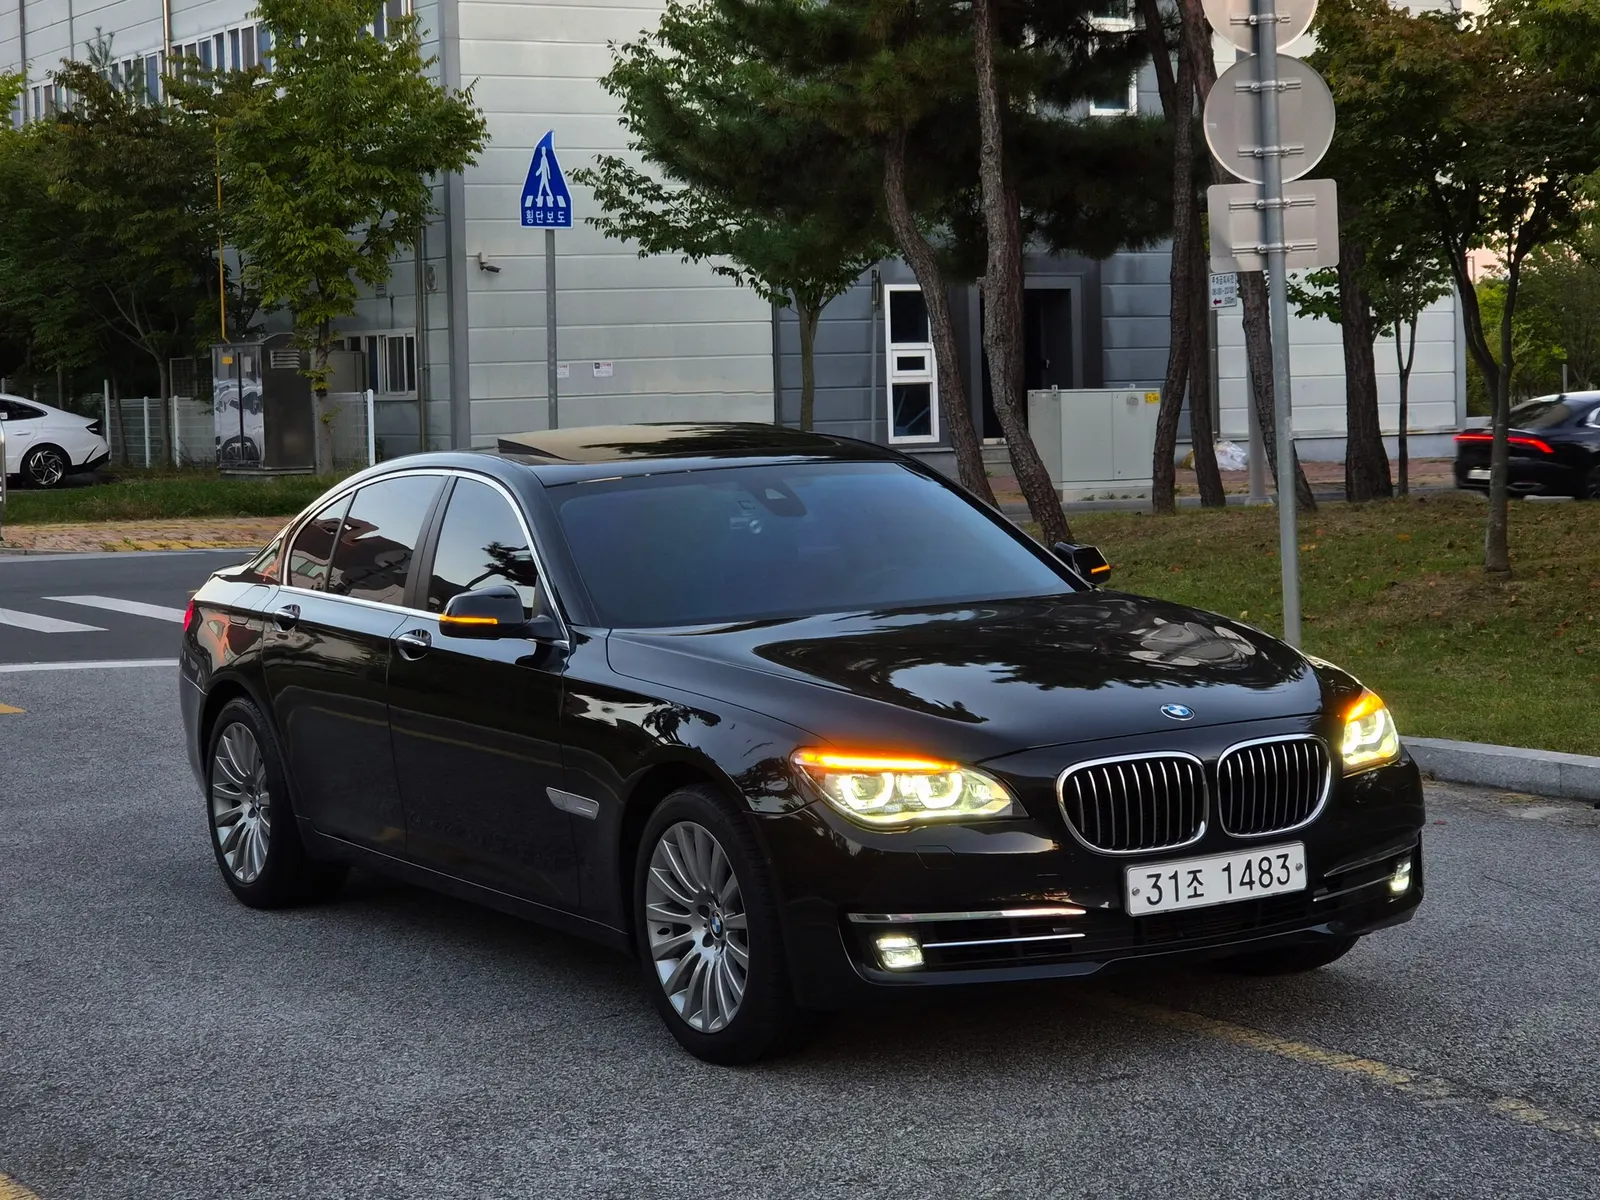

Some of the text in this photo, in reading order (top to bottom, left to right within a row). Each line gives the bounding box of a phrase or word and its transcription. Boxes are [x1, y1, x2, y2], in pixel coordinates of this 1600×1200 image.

[525, 210, 566, 224] 횡단보도
[1146, 853, 1291, 906] 31조 1483
